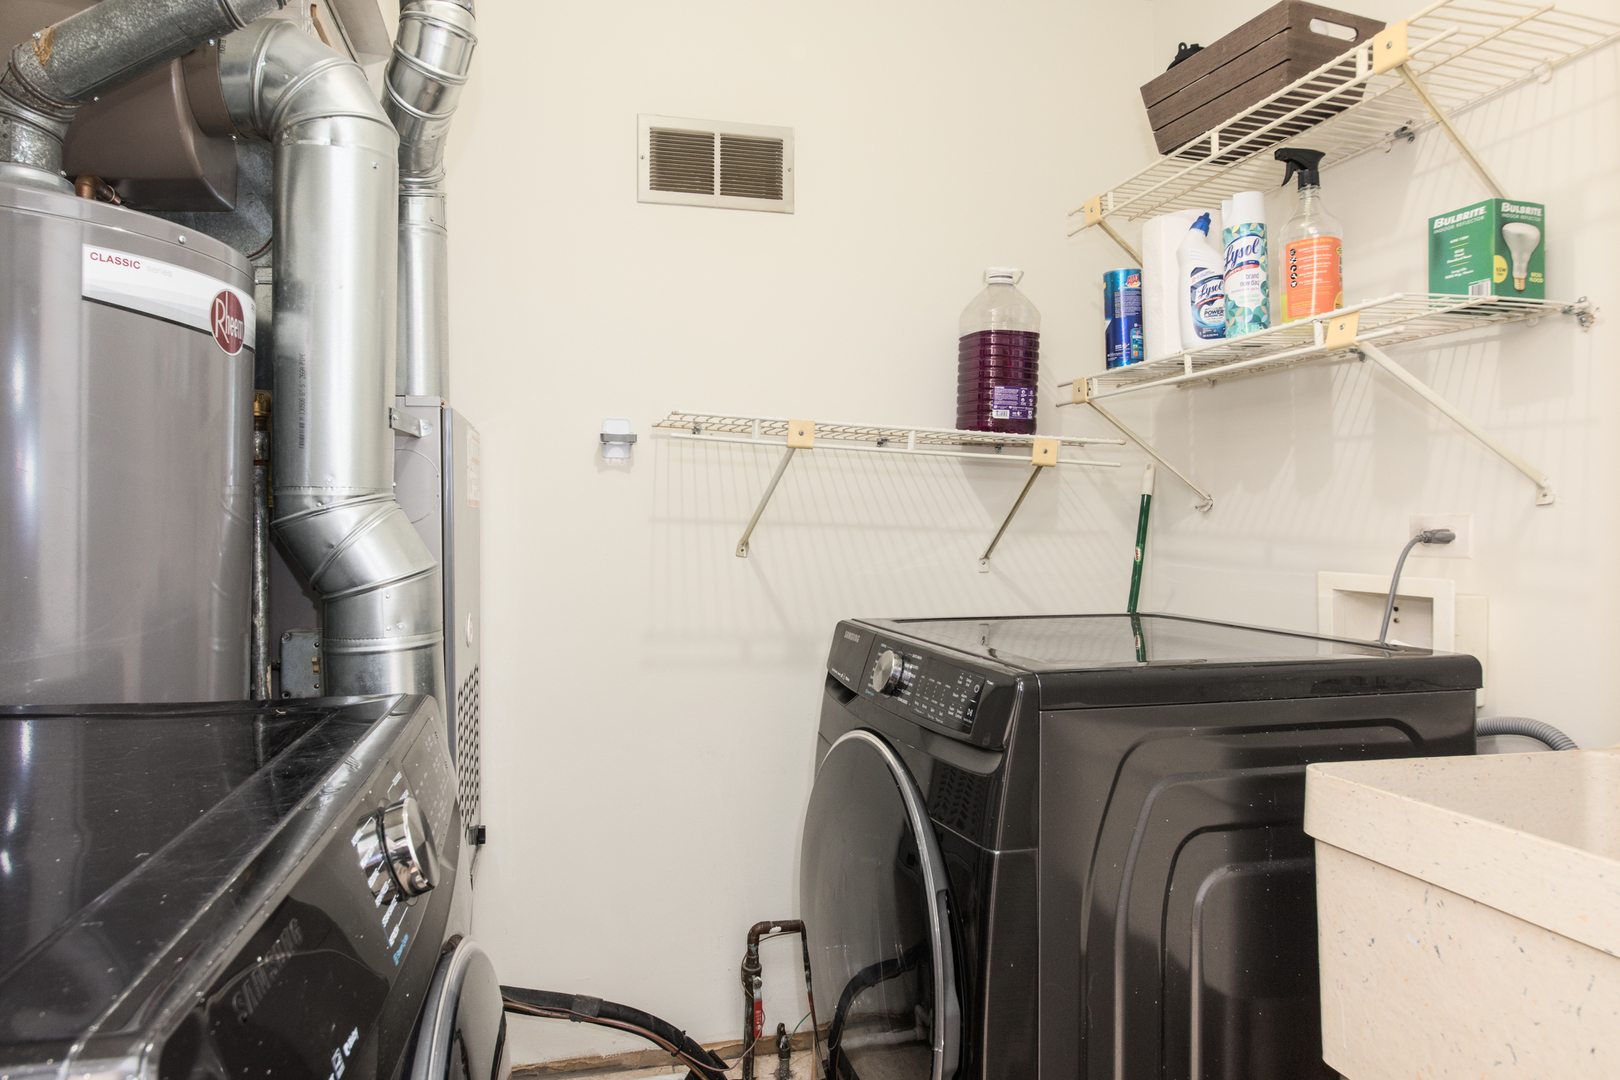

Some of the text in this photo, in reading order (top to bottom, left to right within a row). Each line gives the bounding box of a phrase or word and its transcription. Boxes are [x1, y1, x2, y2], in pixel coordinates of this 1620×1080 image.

[1433, 205, 1487, 229] BULBRITE
[1501, 202, 1542, 216] BULBRITE
[90, 251, 141, 270] CLASSIC
[1223, 237, 1260, 272] Lysol
[1198, 280, 1224, 299] Lysol
[215, 290, 244, 344] Rheem
[232, 917, 303, 1024] SAMSUNG
